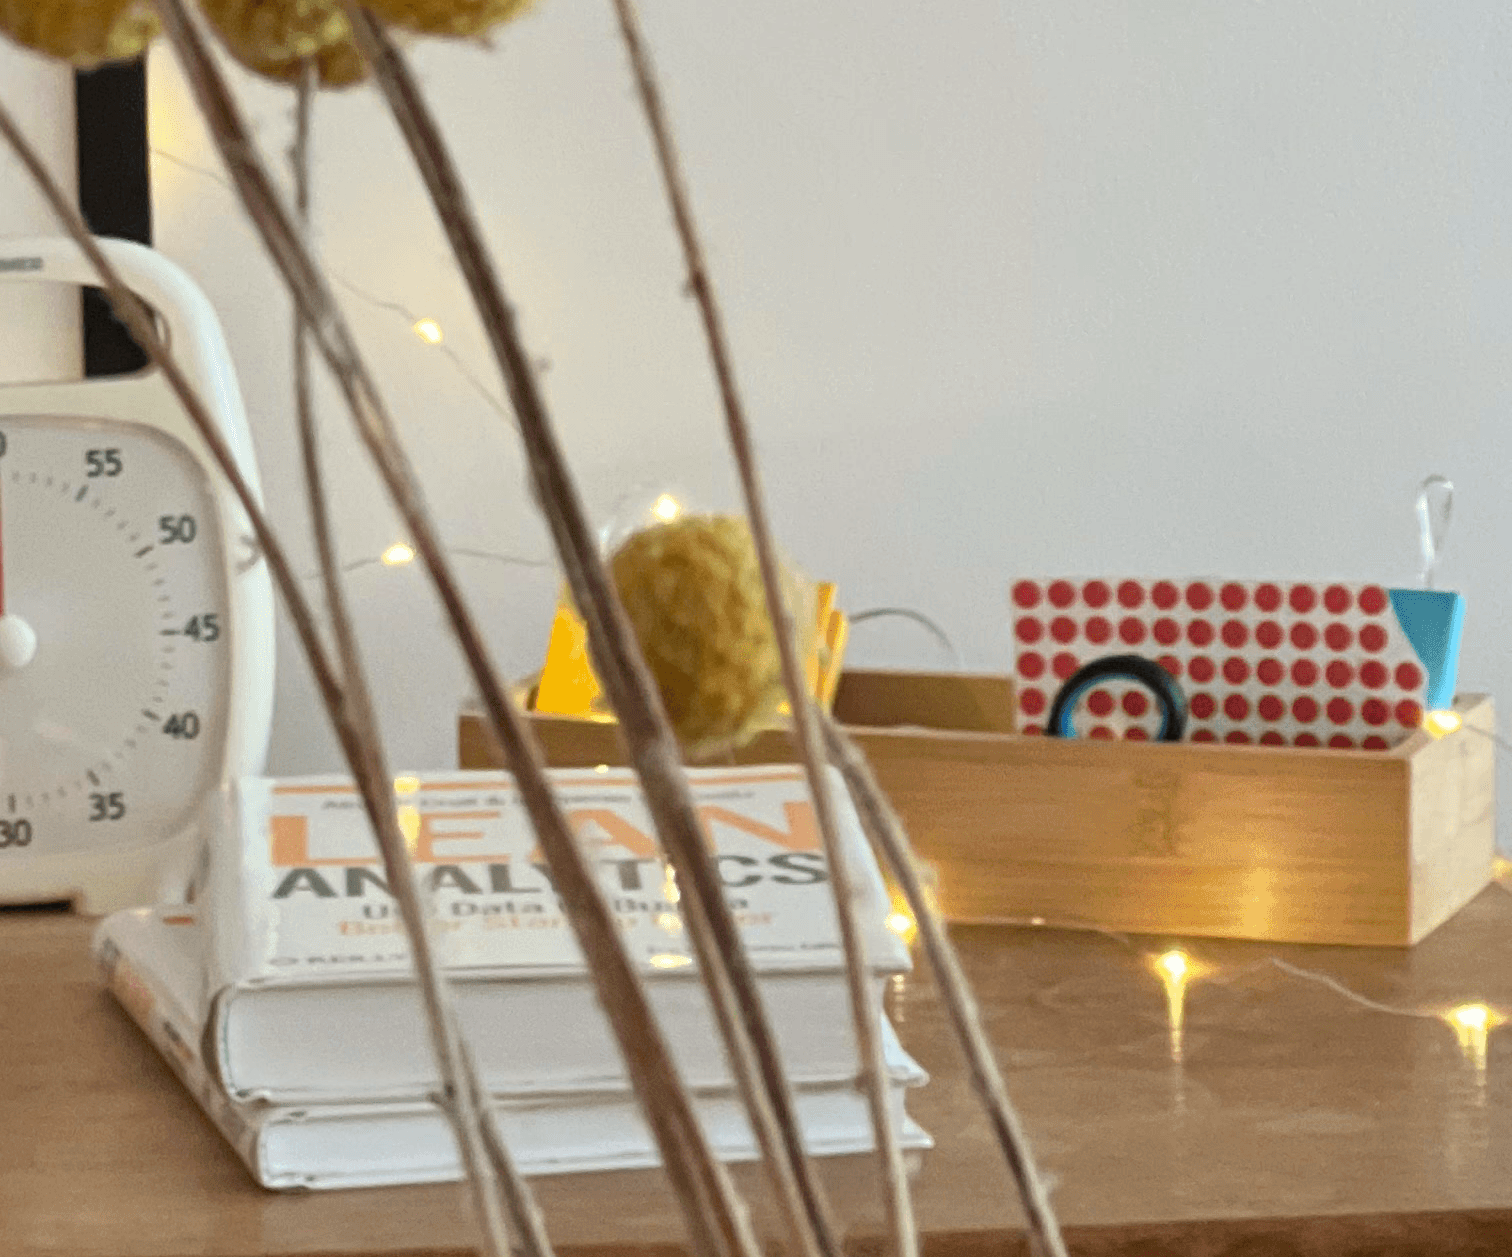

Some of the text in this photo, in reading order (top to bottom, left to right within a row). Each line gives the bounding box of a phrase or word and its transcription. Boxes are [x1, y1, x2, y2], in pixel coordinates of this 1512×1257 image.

[86, 449, 123, 479] 55
[158, 516, 197, 545] 50
[185, 613, 221, 642] 45
[162, 712, 201, 741] 40
[89, 792, 126, 821] 35
[270, 799, 823, 867] LEAN
[272, 852, 831, 899] ANALTCS
